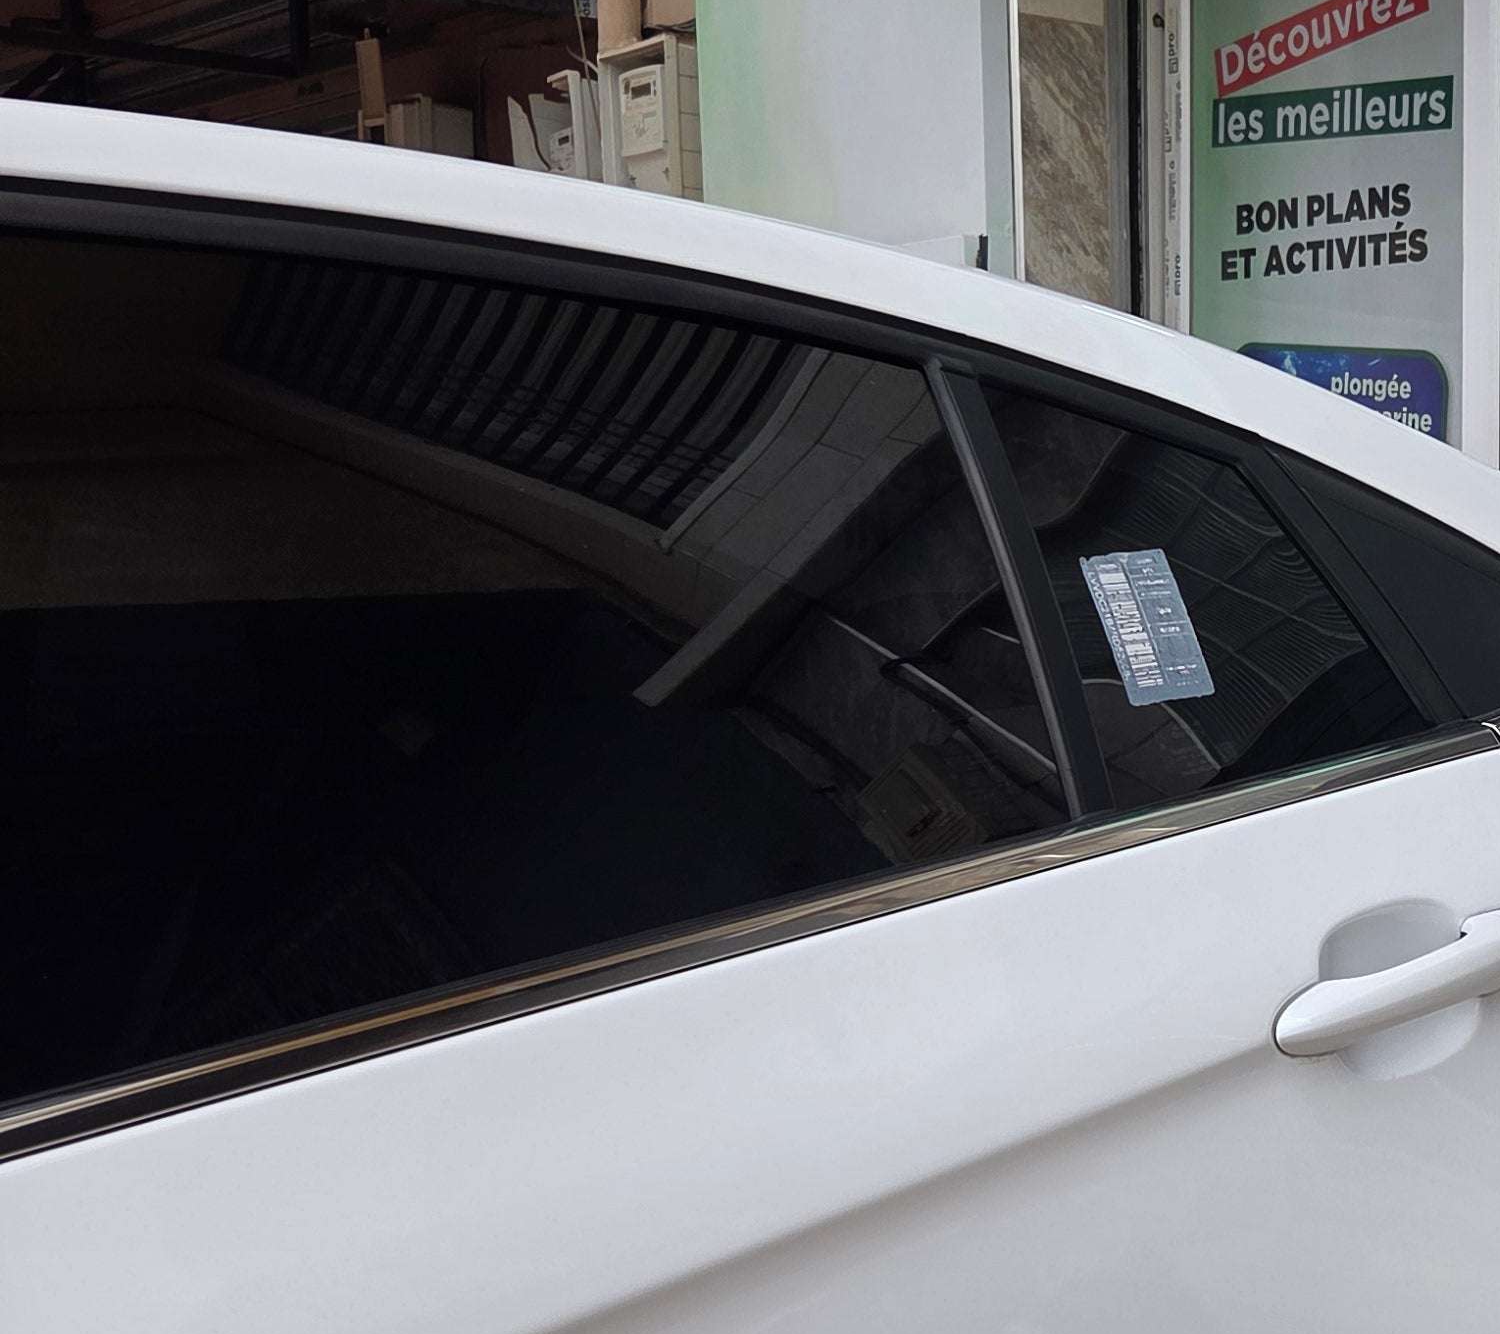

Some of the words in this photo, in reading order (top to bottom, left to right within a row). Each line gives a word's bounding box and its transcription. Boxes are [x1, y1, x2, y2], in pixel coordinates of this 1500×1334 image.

[1217, 102, 1263, 144] les
[1276, 86, 1447, 139] meilleurs
[1236, 197, 1298, 236] BON
[1307, 183, 1411, 227] PLANS
[1221, 247, 1257, 281] ET
[1264, 222, 1429, 278] ACTIVITÉS
[1331, 372, 1412, 401] plongée
